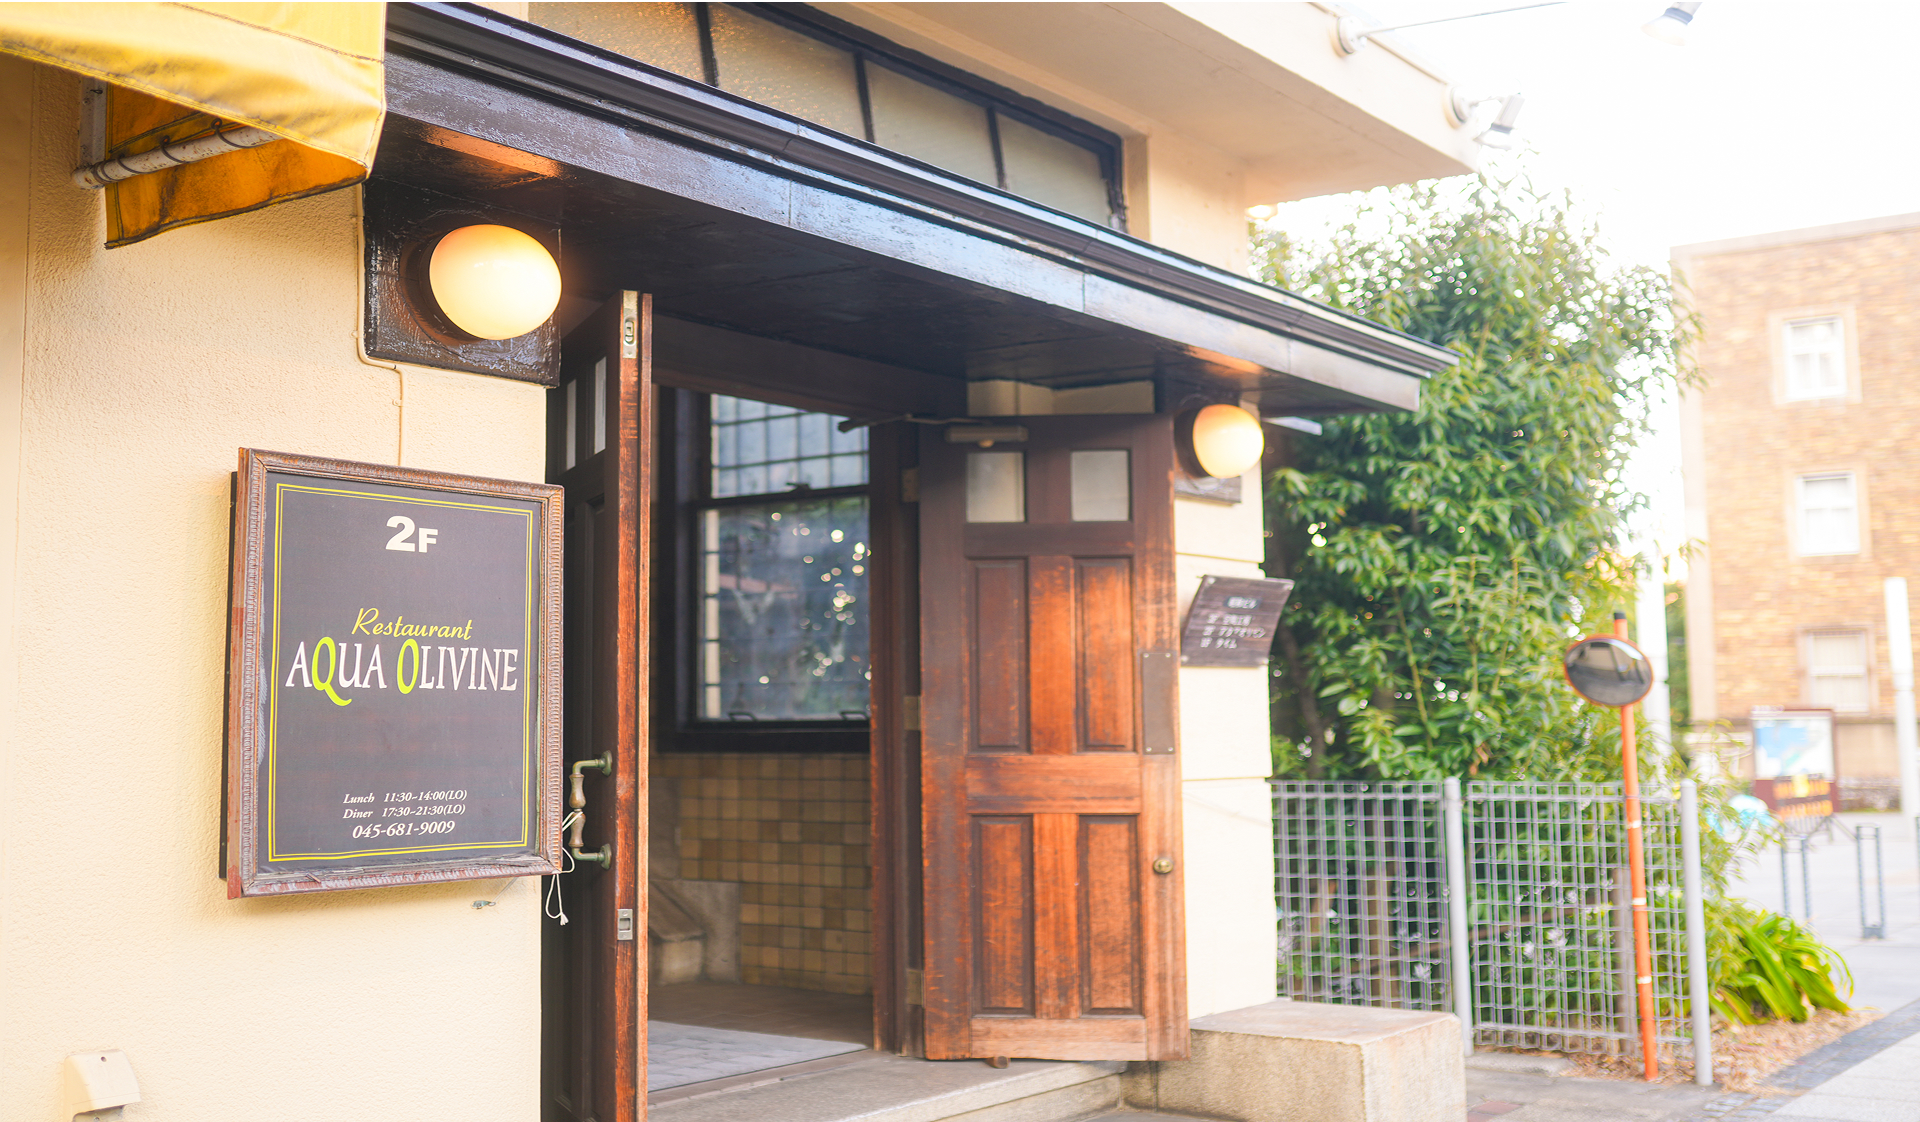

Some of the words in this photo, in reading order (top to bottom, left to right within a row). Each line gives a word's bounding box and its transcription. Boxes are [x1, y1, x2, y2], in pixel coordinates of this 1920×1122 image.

[386, 515, 439, 553] 2F
[351, 607, 473, 640] Restaurant
[285, 636, 388, 706] AQUA
[397, 638, 518, 694] OLIVINE
[342, 792, 375, 804] Lunch
[342, 808, 374, 819] Diner
[352, 820, 456, 838] 045-681-9009
